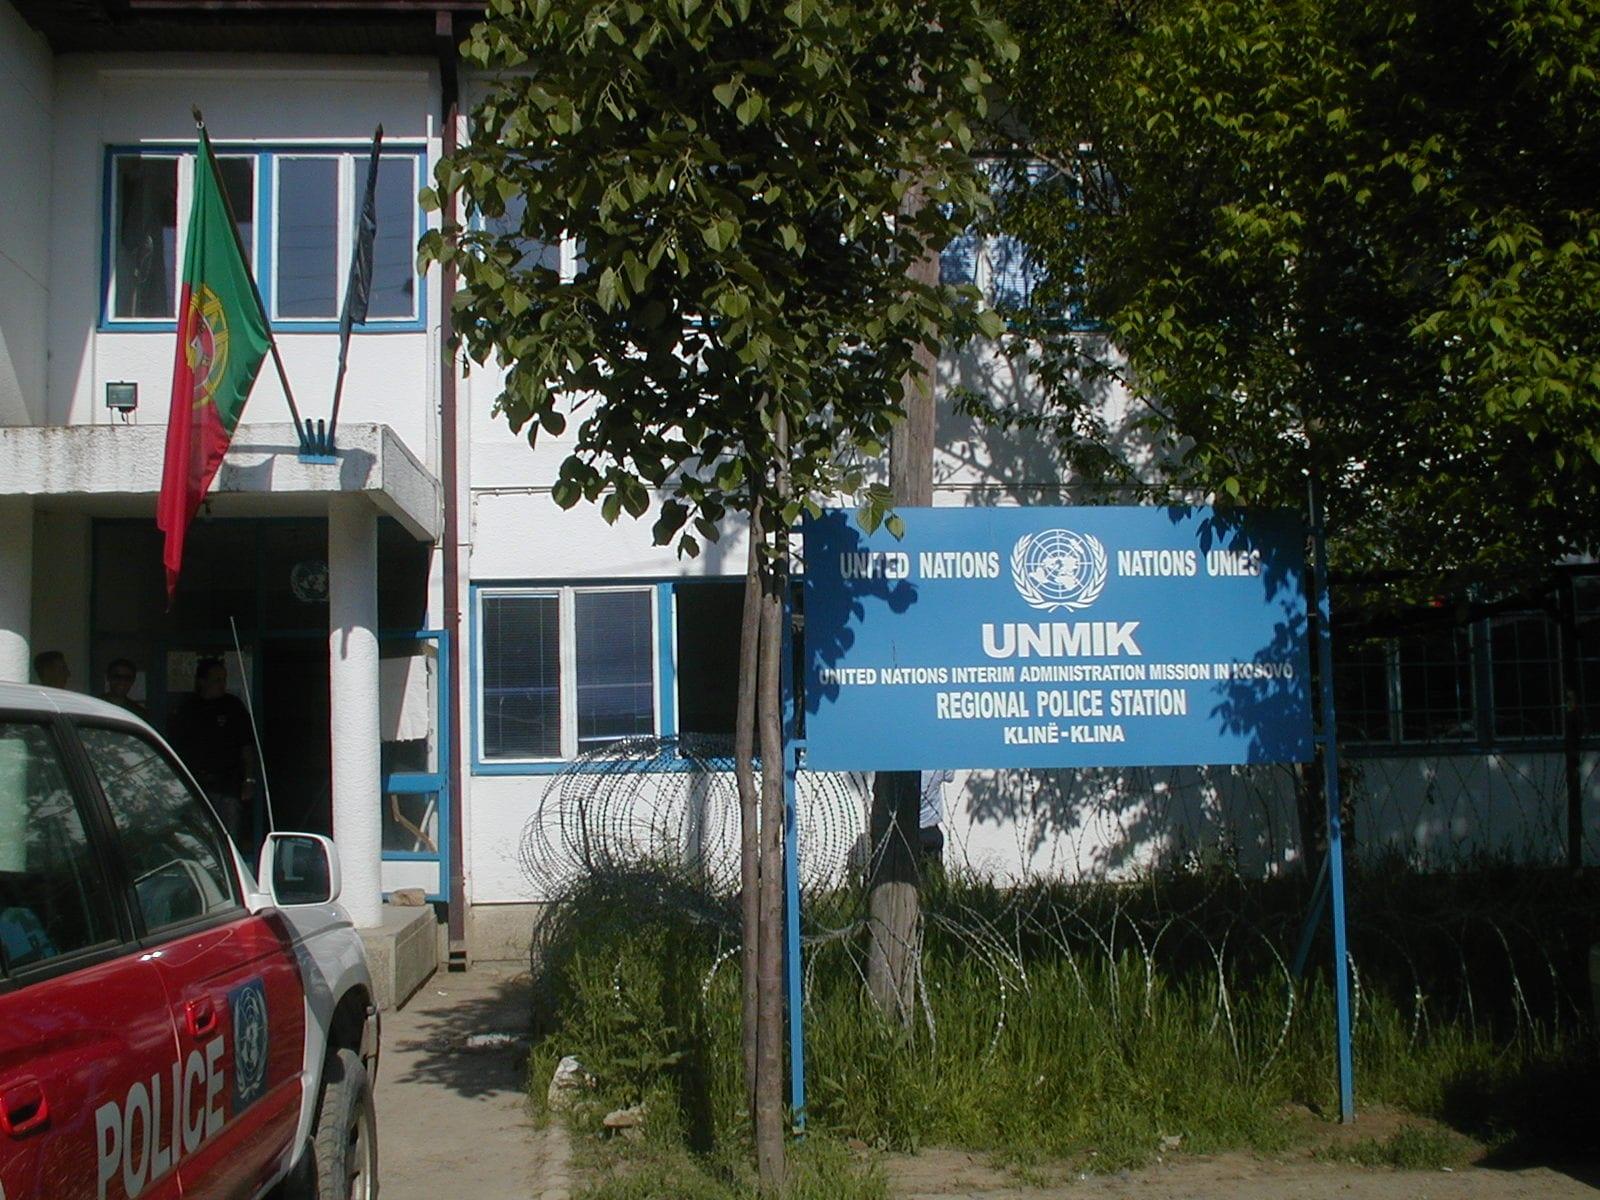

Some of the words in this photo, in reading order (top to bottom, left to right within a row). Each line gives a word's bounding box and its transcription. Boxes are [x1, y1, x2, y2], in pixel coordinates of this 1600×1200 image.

[840, 552, 910, 580] UNITED
[919, 551, 1000, 579] NATIONS
[1117, 550, 1197, 577] NATIONS
[1206, 549, 1262, 577] UNIES
[981, 621, 1142, 659] UNMIK
[819, 668, 877, 685] UNITED
[881, 668, 948, 685] NATIONS
[952, 666, 1015, 683] INTERIM
[1020, 664, 1145, 683] ADMINISTRATION
[1150, 663, 1210, 681] MISSION
[1214, 663, 1230, 680] IN
[1233, 661, 1294, 679] KOSOVO
[936, 692, 1030, 720] REGIONAL
[1036, 690, 1104, 718] POLICE
[1110, 689, 1187, 716] STATION
[95, 1034, 225, 1200] POLICE
